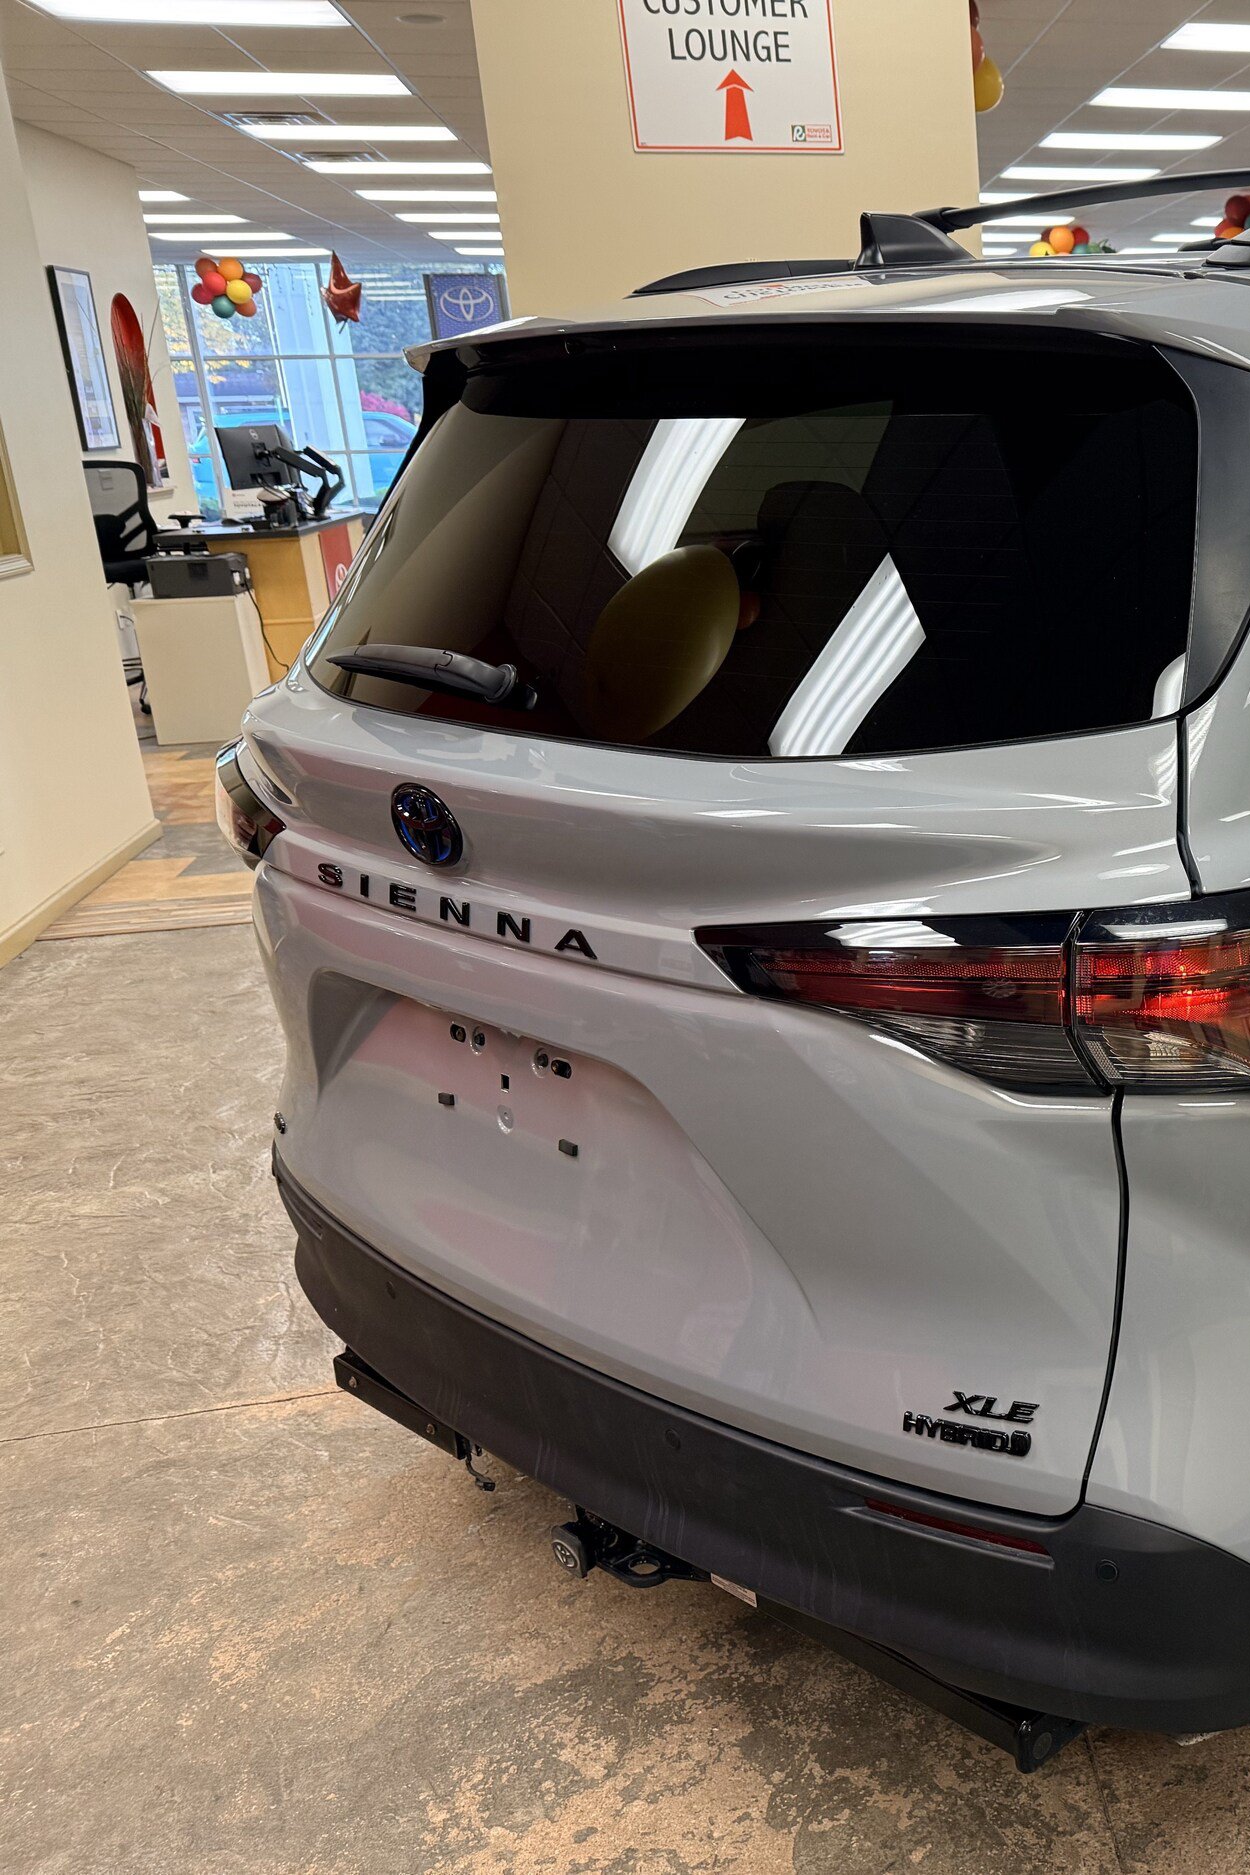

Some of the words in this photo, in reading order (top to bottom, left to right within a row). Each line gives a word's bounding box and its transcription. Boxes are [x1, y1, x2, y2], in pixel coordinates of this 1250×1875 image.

[668, 28, 792, 63] LOUNGE
[318, 862, 598, 960] SIENNA
[943, 1390, 1040, 1424] XLE
[903, 1411, 1011, 1453] HYBRID
